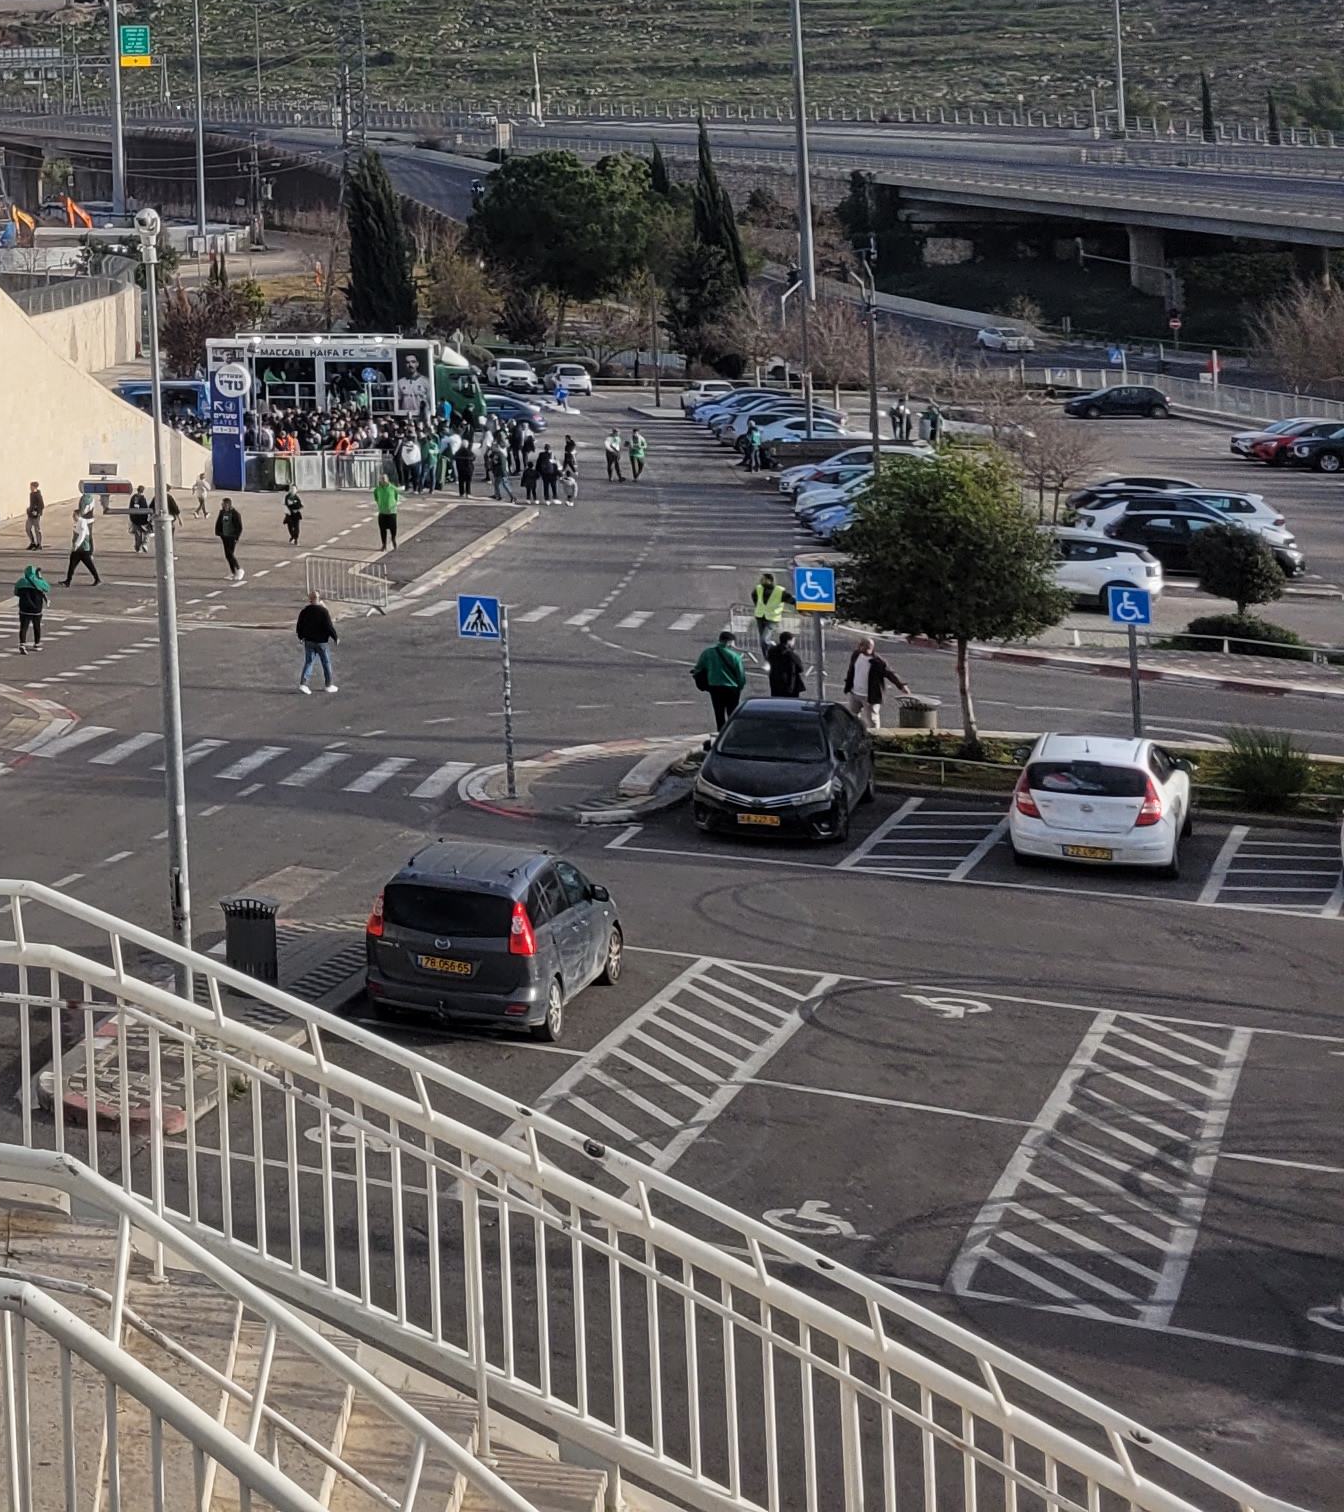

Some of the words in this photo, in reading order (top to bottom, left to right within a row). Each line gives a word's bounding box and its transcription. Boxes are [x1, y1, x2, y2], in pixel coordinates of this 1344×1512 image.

[260, 348, 305, 357] MACCABI
[309, 349, 340, 357] HAIFA
[342, 348, 355, 357] FC
[219, 380, 244, 391] טדי
